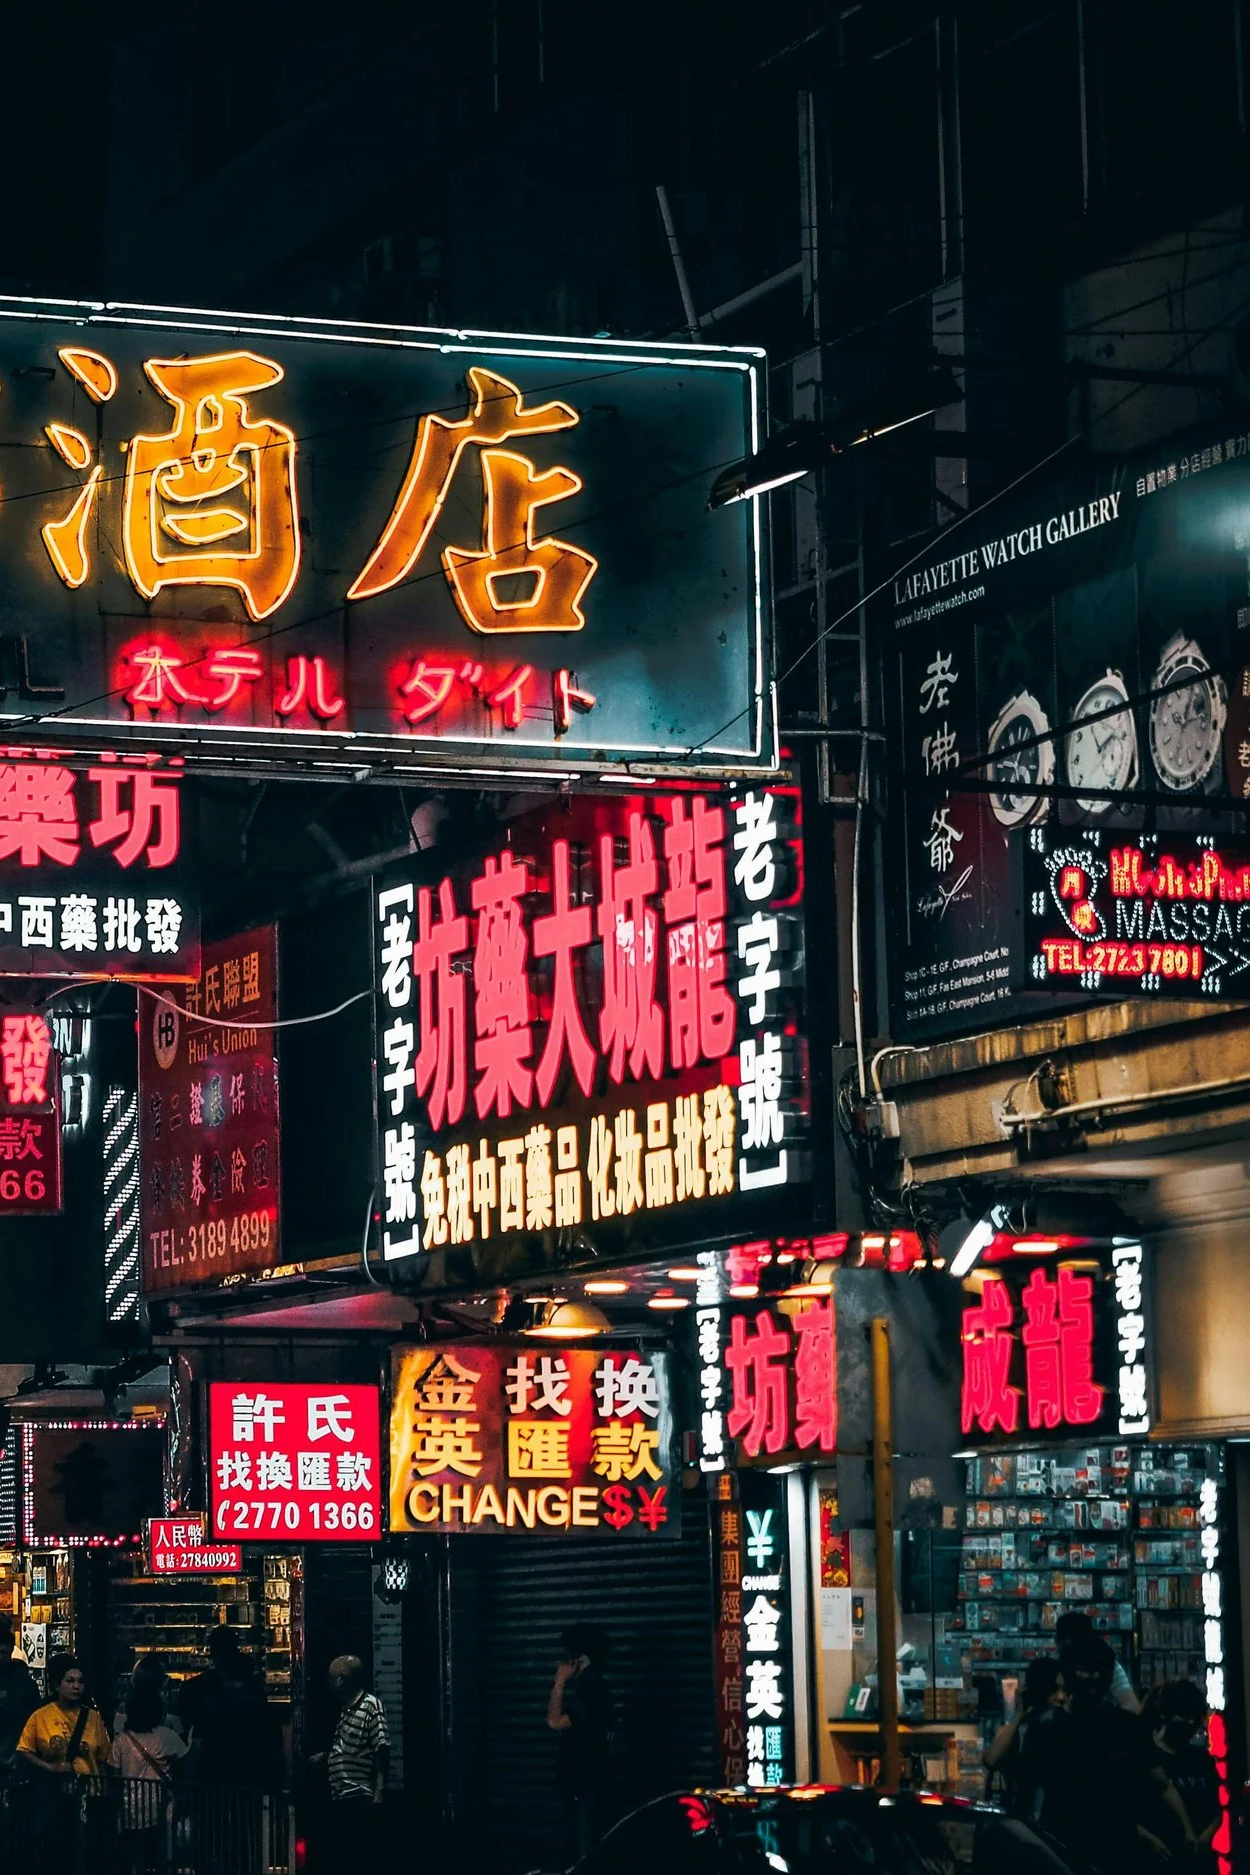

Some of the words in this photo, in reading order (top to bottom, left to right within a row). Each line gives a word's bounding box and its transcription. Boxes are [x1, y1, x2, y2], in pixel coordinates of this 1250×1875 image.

[893, 550, 980, 606] LAFAYETTE
[980, 522, 1043, 571] WATCH
[1045, 490, 1122, 546] GALLERY
[893, 584, 986, 631] www.lafayettewatch.com
[222, 1026, 258, 1053] Union
[587, 1082, 738, 1223] 化妝品批發
[188, 1217, 227, 1263] 3189
[230, 1208, 270, 1254] 4899
[231, 1393, 356, 1443] 許氏
[216, 1450, 373, 1493] 找換匯款
[233, 1503, 300, 1531] 2770
[308, 1503, 374, 1531] 1366
[408, 1482, 599, 1530] CHANGE
